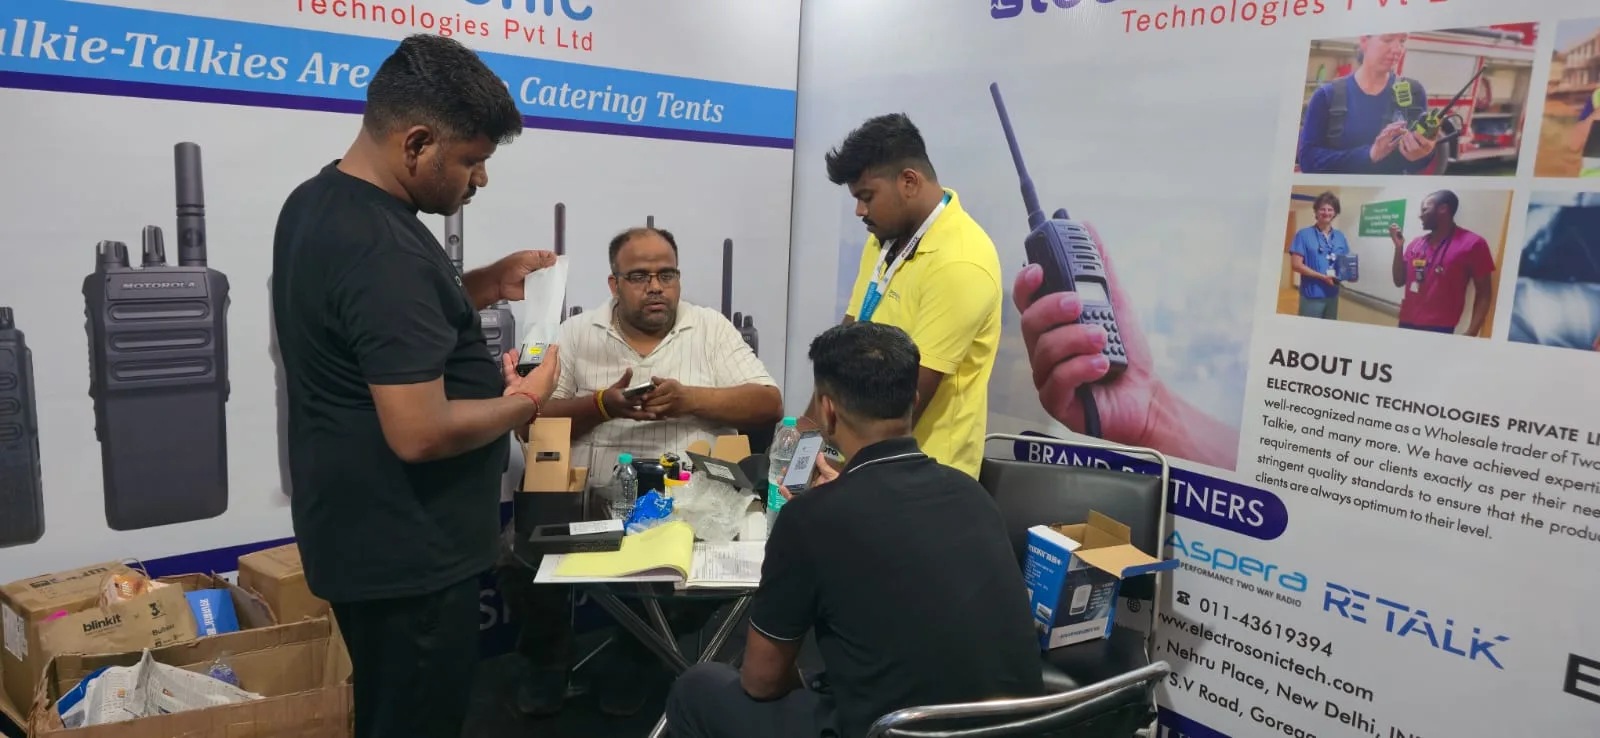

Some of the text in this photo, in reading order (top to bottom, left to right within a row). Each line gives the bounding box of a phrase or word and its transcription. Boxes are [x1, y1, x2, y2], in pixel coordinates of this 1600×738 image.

[505, 19, 545, 44] Pvt
[557, 27, 593, 51] Ltd
[1121, 0, 1325, 33] Technologies
[0, 18, 371, 88] lkie-Talkies Are
[520, 77, 724, 122] Catering Tents
[1269, 348, 1393, 383] ABOUT US
[1264, 398, 1355, 423] well-recognized
[1357, 416, 1392, 431] name
[1394, 423, 1409, 434] as
[1411, 426, 1421, 436] a
[1425, 425, 1498, 451] Wholesale
[1501, 440, 1548, 460] trader
[1550, 450, 1569, 464] of
[1266, 377, 1370, 405] ELECTROSONIC
[1376, 395, 1500, 428] TECHNOLOGIES
[1507, 418, 1579, 442] PRIVATE
[1259, 436, 1332, 459] requirements
[1336, 450, 1350, 463] of
[1353, 456, 1374, 468] our
[1379, 459, 1418, 478] clients
[1423, 472, 1473, 493] exactly
[1478, 484, 1494, 495] as
[1500, 488, 1526, 502] per
[1532, 491, 1567, 510] their
[1262, 414, 1600, 494] Talkie, and many more. We have achieved experti
[1255, 472, 1493, 540] clients are always optimum to their level.
[1257, 454, 1304, 472] stringent
[1308, 467, 1348, 486] quality
[1351, 475, 1414, 498] standards
[1418, 490, 1431, 502] to
[1436, 496, 1482, 514] ensure
[1487, 504, 1516, 521] that
[1520, 512, 1545, 529] the
[1164, 530, 1308, 592] Aspera
[1180, 562, 1302, 608] PERFORMANCE TWO WAY RADIO
[83, 613, 122, 633] blinkit
[1199, 598, 1333, 657] 011-43619394
[1159, 612, 1374, 702] ww.electrosonictech.com
[1167, 639, 1216, 670] Nehru
[1221, 660, 1269, 695] Place,
[1277, 682, 1318, 710] New
[1169, 671, 1194, 691] S.V
[1199, 684, 1243, 717] Road,
